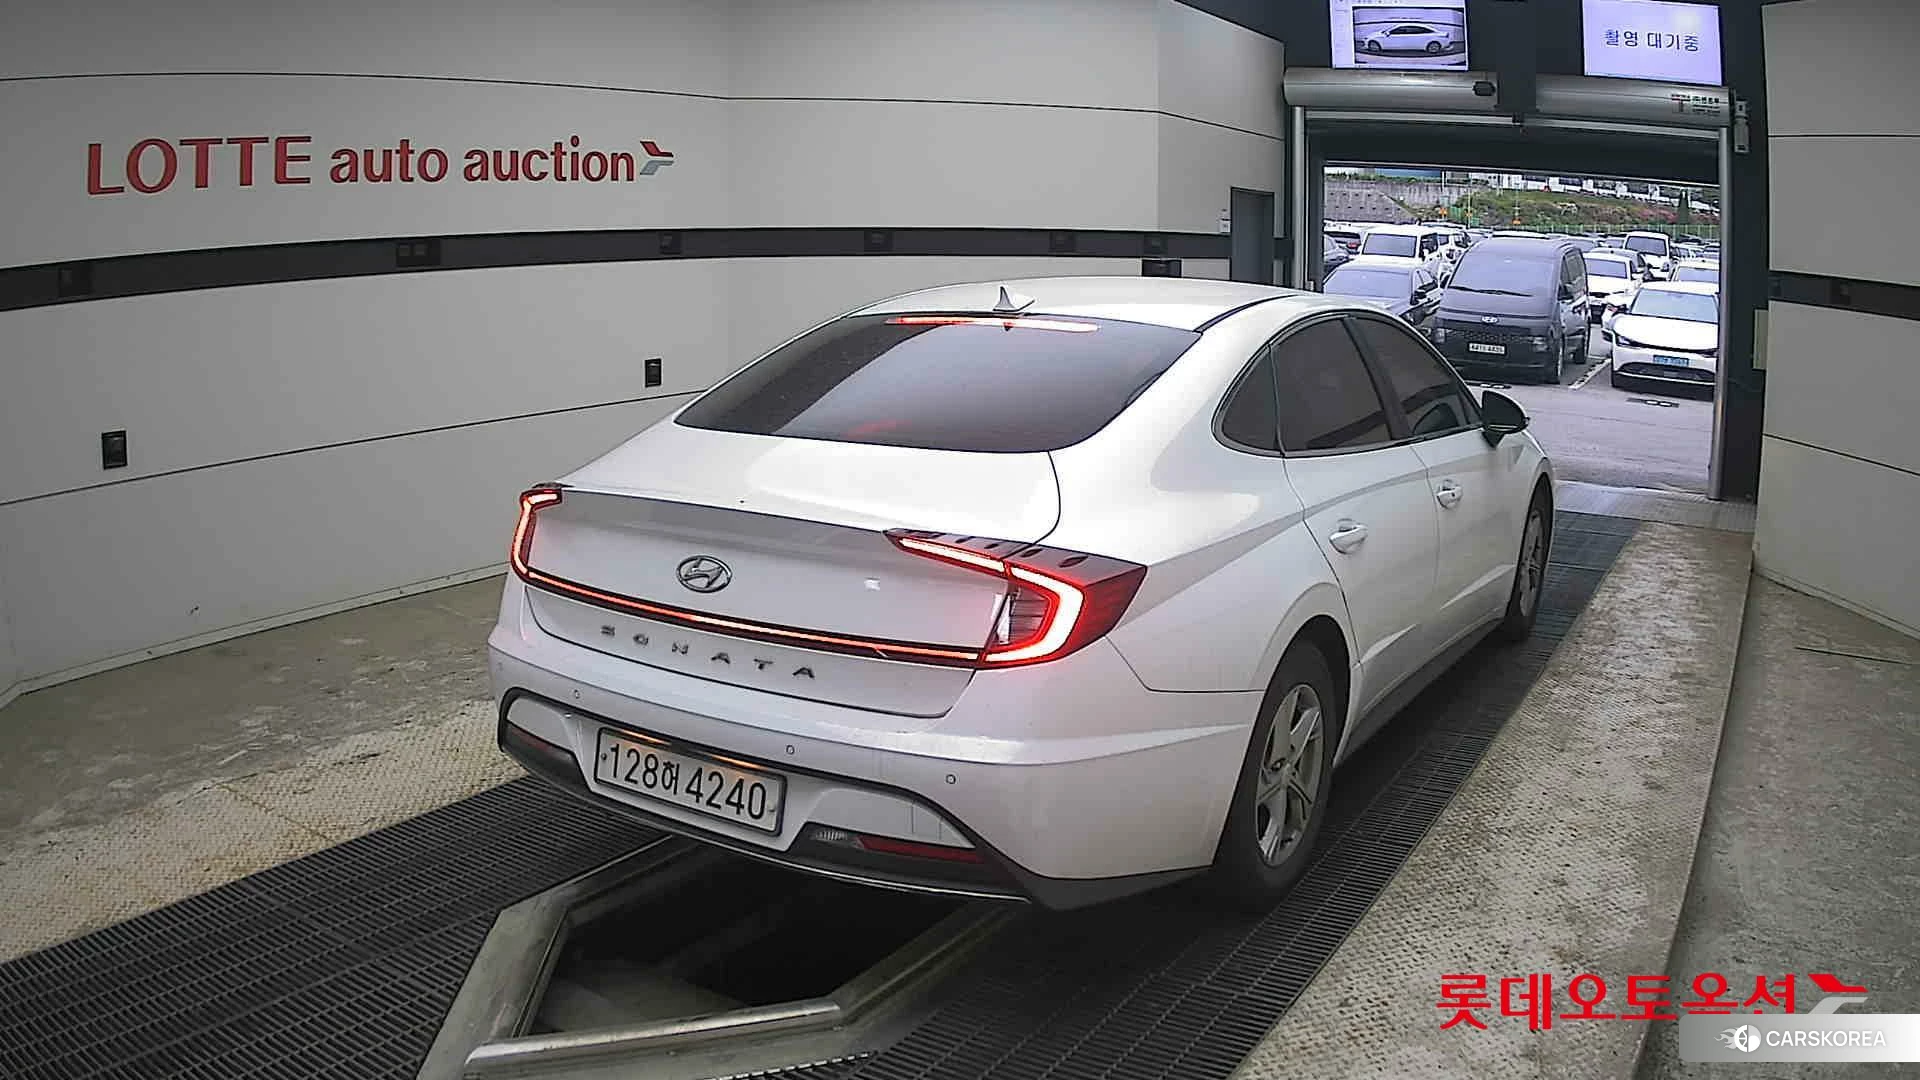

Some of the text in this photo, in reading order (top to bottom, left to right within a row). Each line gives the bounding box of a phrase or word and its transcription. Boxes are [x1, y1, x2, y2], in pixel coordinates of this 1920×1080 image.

[1647, 32, 1699, 51] 대기중
[87, 135, 635, 195] LOTTE auto auction
[601, 624, 815, 679] SONATA
